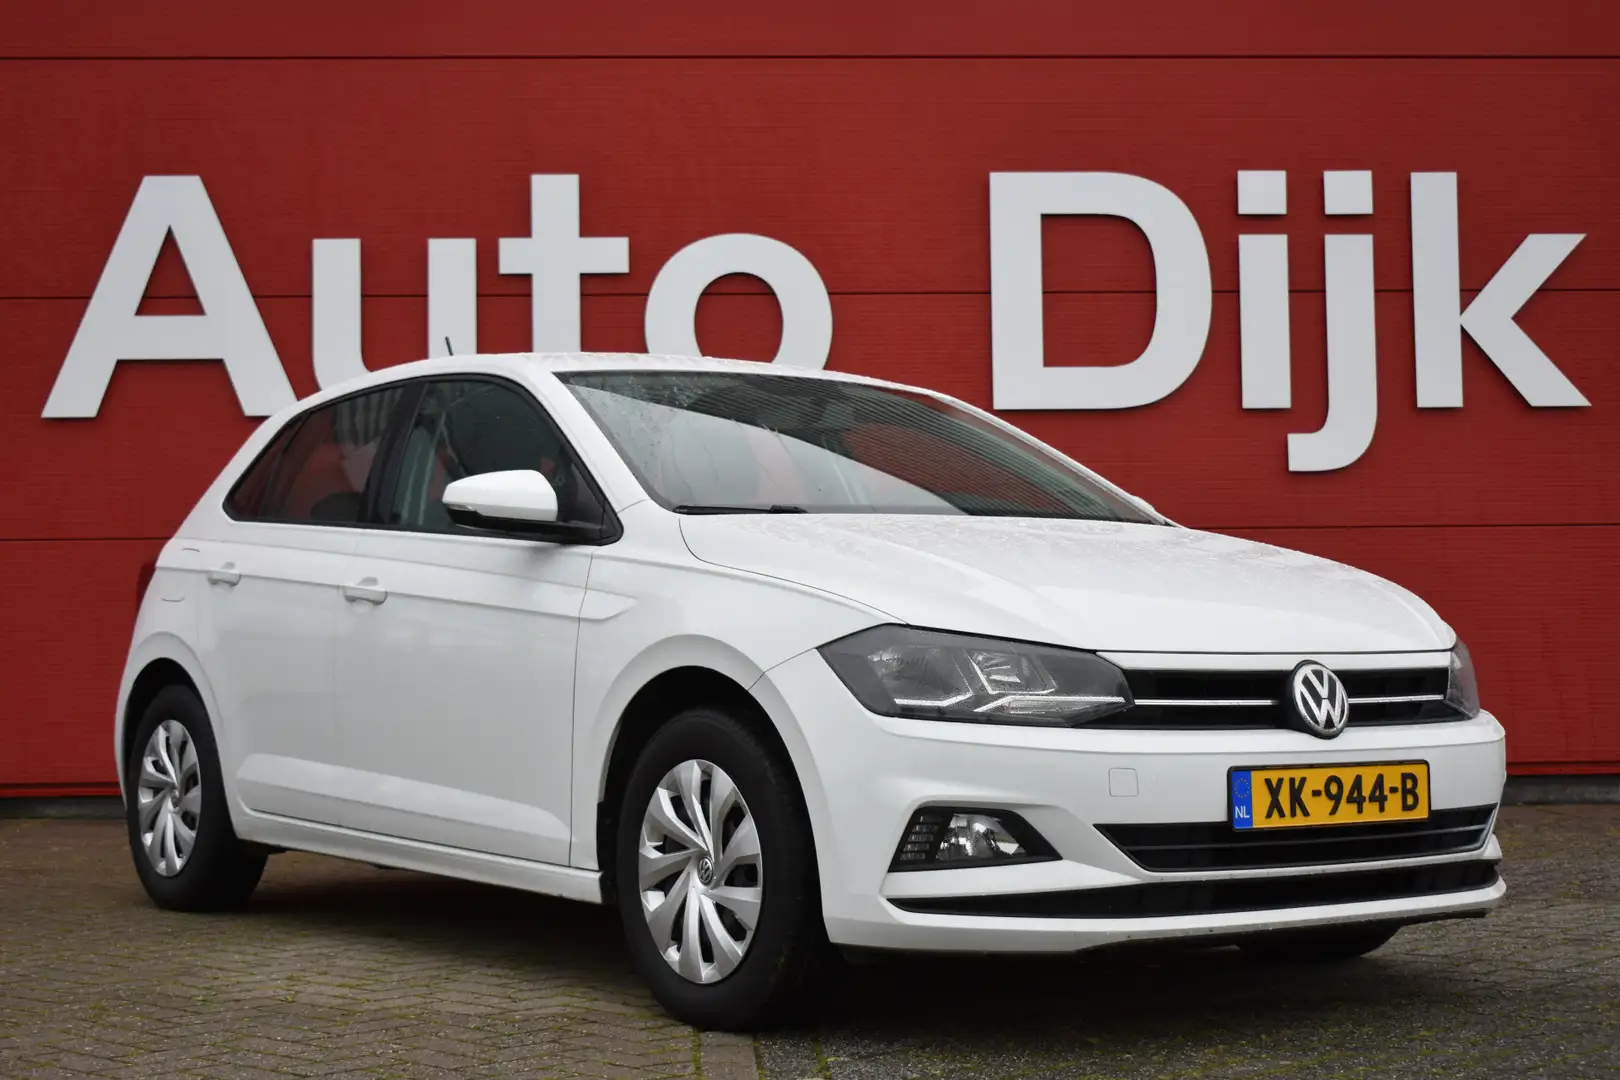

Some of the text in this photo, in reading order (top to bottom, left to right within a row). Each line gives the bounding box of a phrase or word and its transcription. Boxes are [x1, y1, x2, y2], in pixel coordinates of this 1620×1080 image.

[41, 170, 1592, 472] Auto Dijk
[1234, 805, 1250, 819] NL
[1264, 772, 1419, 819] XK-944-B
